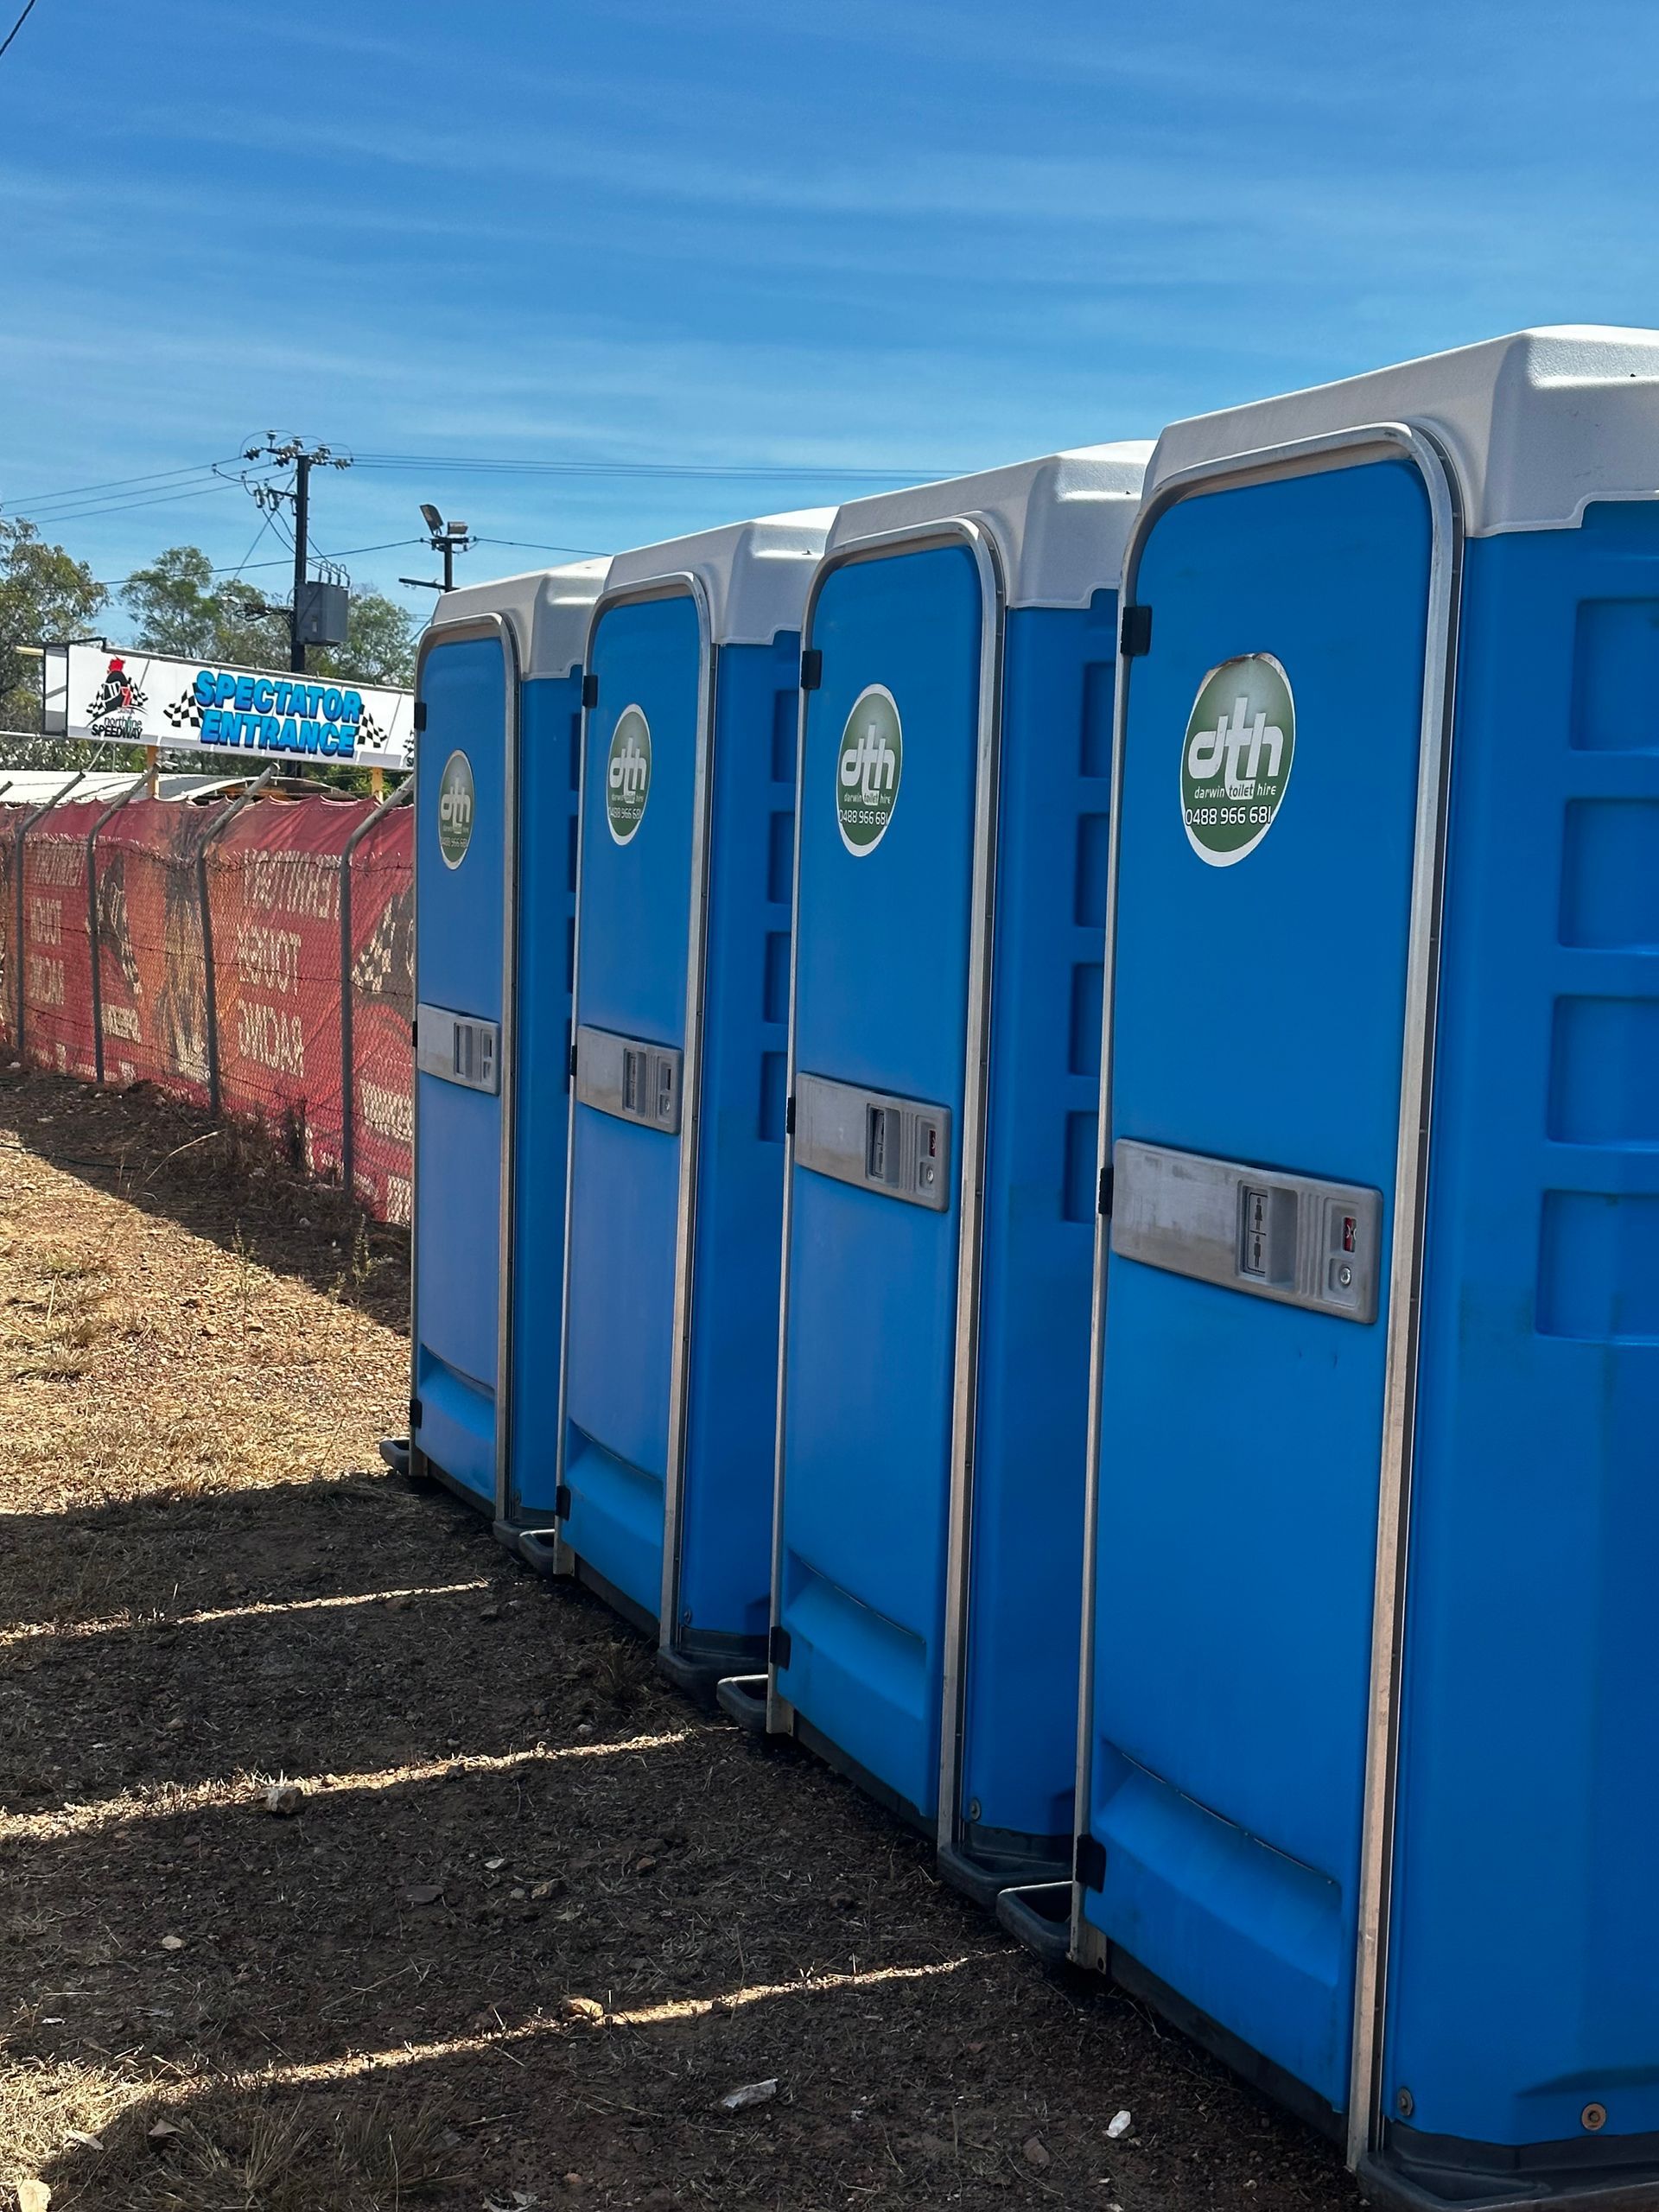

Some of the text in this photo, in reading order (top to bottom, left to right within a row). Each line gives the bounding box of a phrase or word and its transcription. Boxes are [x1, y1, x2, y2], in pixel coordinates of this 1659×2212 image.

[196, 671, 362, 724] SPECTATOR
[91, 724, 143, 741] SPEEDWAY
[200, 709, 359, 758] ENTRANCE
[1194, 783, 1277, 799] darwin toilet hire
[858, 810, 874, 824] 966
[1185, 805, 1272, 825] 0488 966 681
